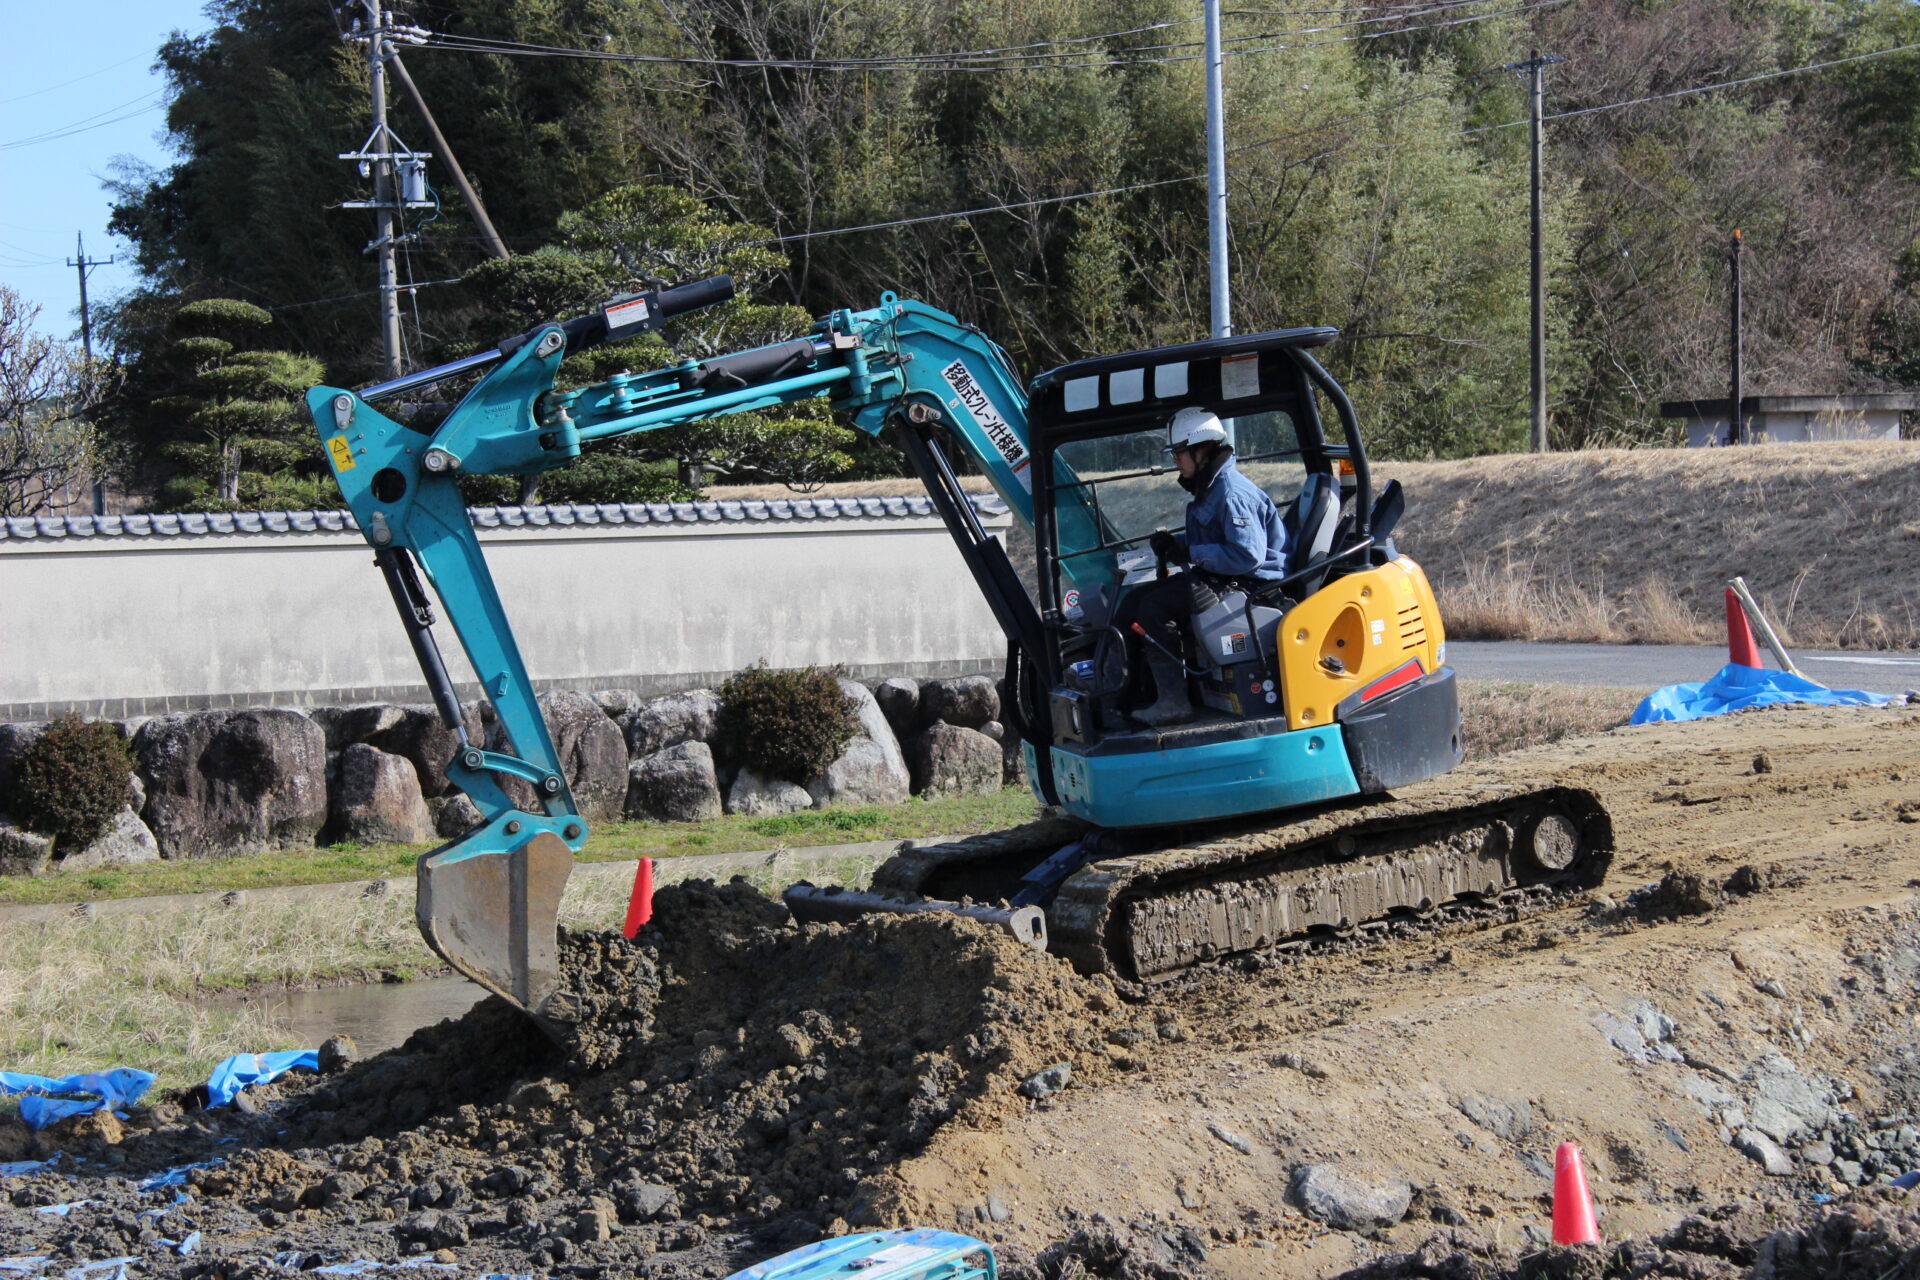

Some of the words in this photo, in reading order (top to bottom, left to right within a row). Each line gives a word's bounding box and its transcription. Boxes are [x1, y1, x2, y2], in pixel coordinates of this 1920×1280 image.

[944, 362, 1024, 463] 移動式クレーン仕様機
